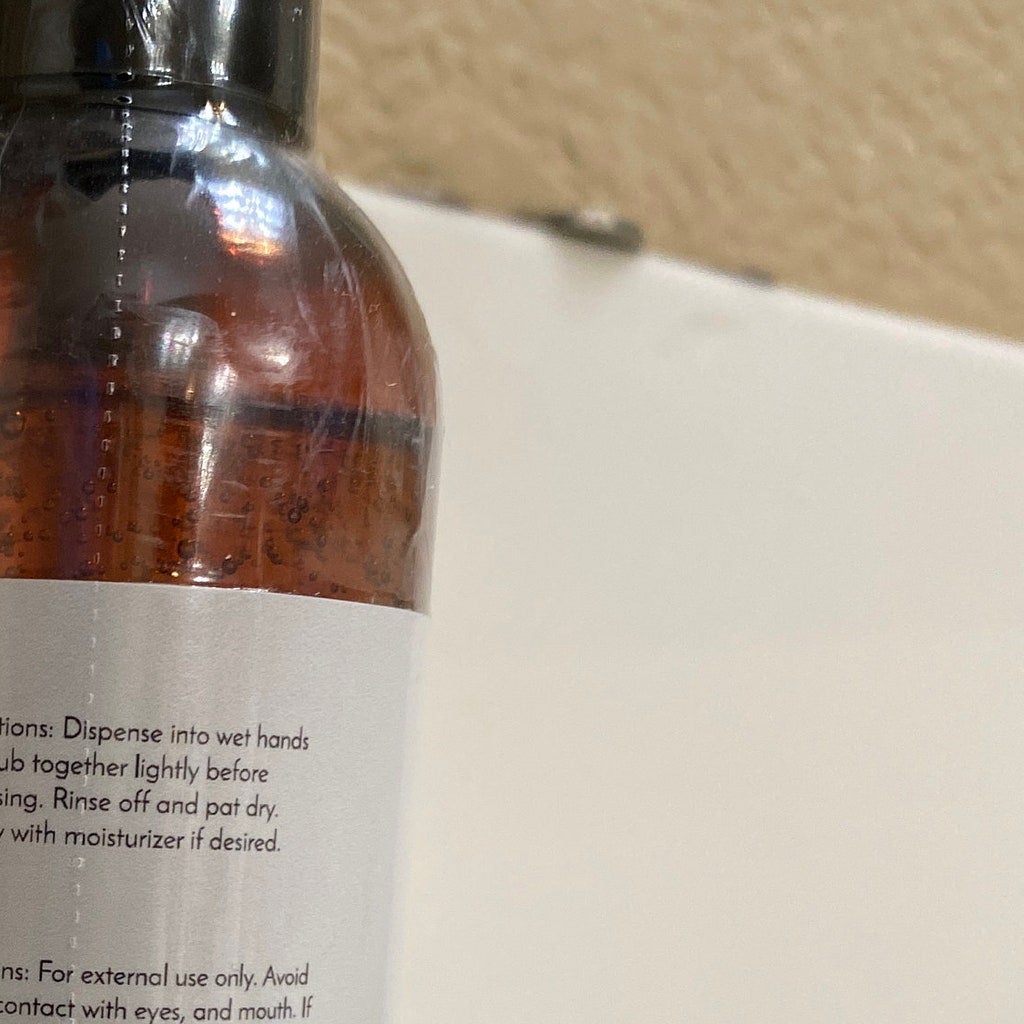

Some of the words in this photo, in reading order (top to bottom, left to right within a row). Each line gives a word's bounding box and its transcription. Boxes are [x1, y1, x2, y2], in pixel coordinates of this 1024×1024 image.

[64, 716, 162, 746] Dispense
[171, 724, 209, 746] into
[216, 728, 252, 748] wet
[257, 724, 309, 752] hands
[33, 753, 128, 779] together
[135, 753, 199, 786] lightly
[207, 757, 269, 784] before
[53, 787, 111, 812] Rinse
[118, 789, 151, 813] off
[157, 792, 199, 816] and
[205, 798, 241, 826] pat
[245, 794, 279, 823] dry.
[10, 820, 56, 845] with
[65, 829, 185, 850] moisturizer
[190, 825, 204, 851] if
[209, 829, 281, 853] desired.
[39, 960, 74, 983] For
[81, 963, 169, 988] external
[175, 970, 208, 988] use
[215, 964, 257, 992] only.
[262, 963, 309, 987] Avoid
[82, 996, 127, 1021] with
[134, 1005, 185, 1024] eyes,
[193, 998, 232, 1022] and
[238, 998, 297, 1021] mouth.
[302, 996, 314, 1019] If
